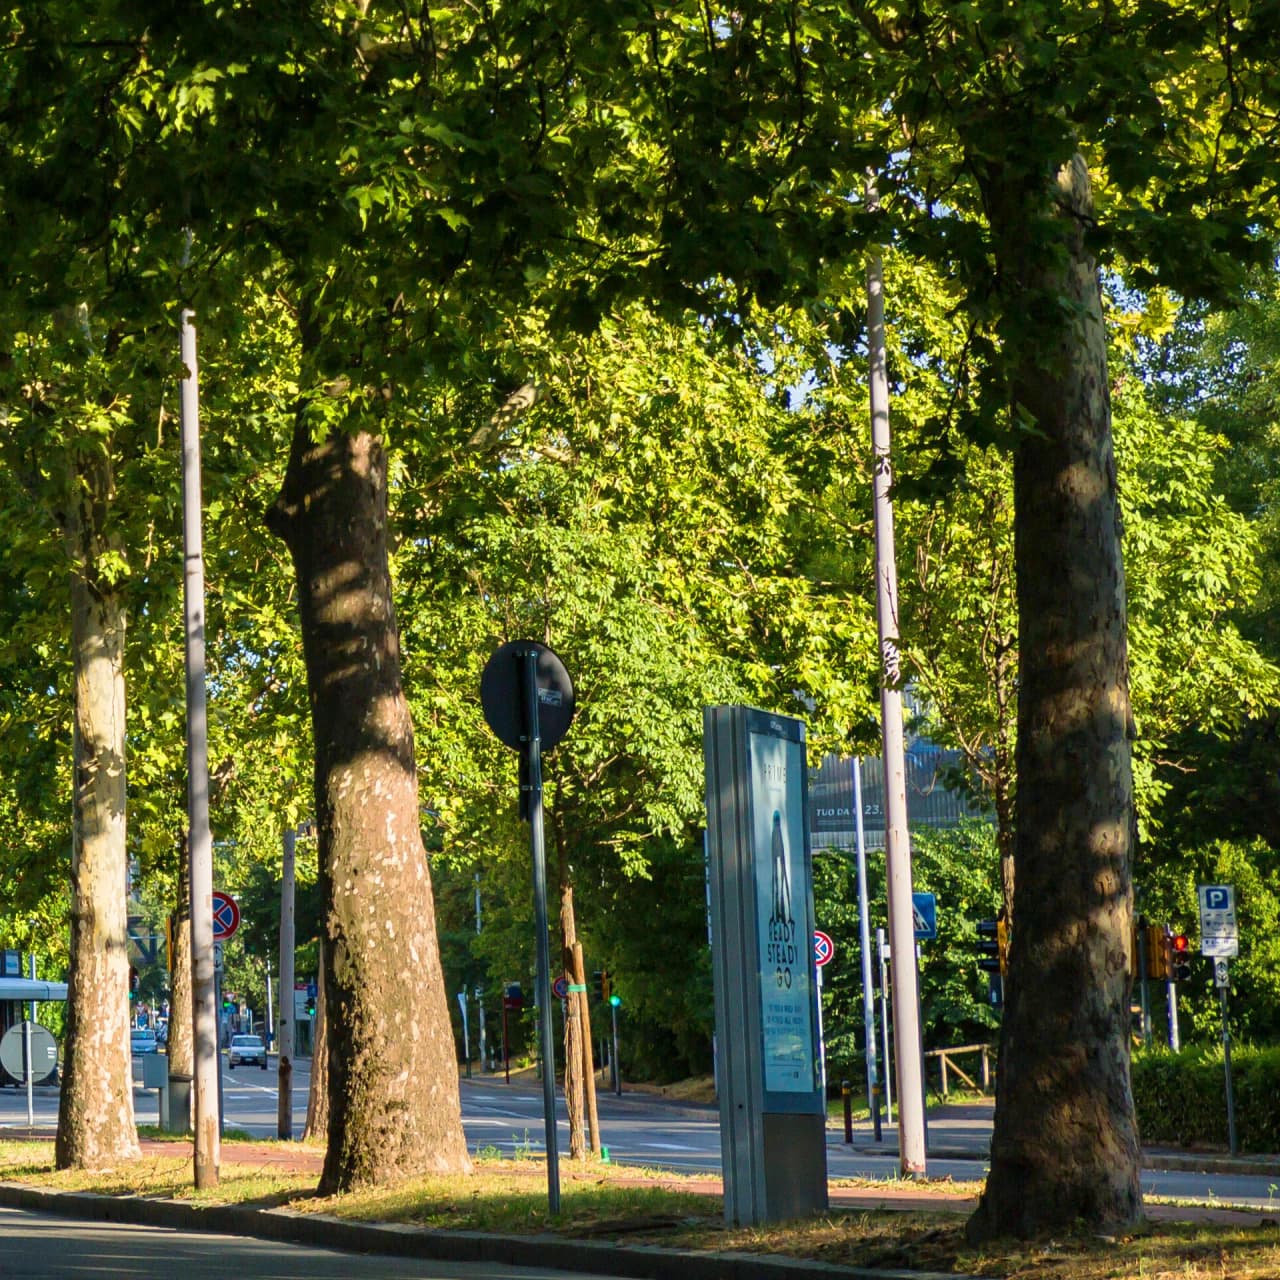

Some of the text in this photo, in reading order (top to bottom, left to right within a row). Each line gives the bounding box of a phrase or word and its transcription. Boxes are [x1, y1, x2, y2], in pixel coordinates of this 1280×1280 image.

[816, 808, 835, 817] TUO
[837, 808, 850, 816] DA
[1210, 891, 1223, 907] P
[769, 919, 796, 943] READY
[768, 943, 798, 965] STEADY
[776, 966, 792, 989] GO
